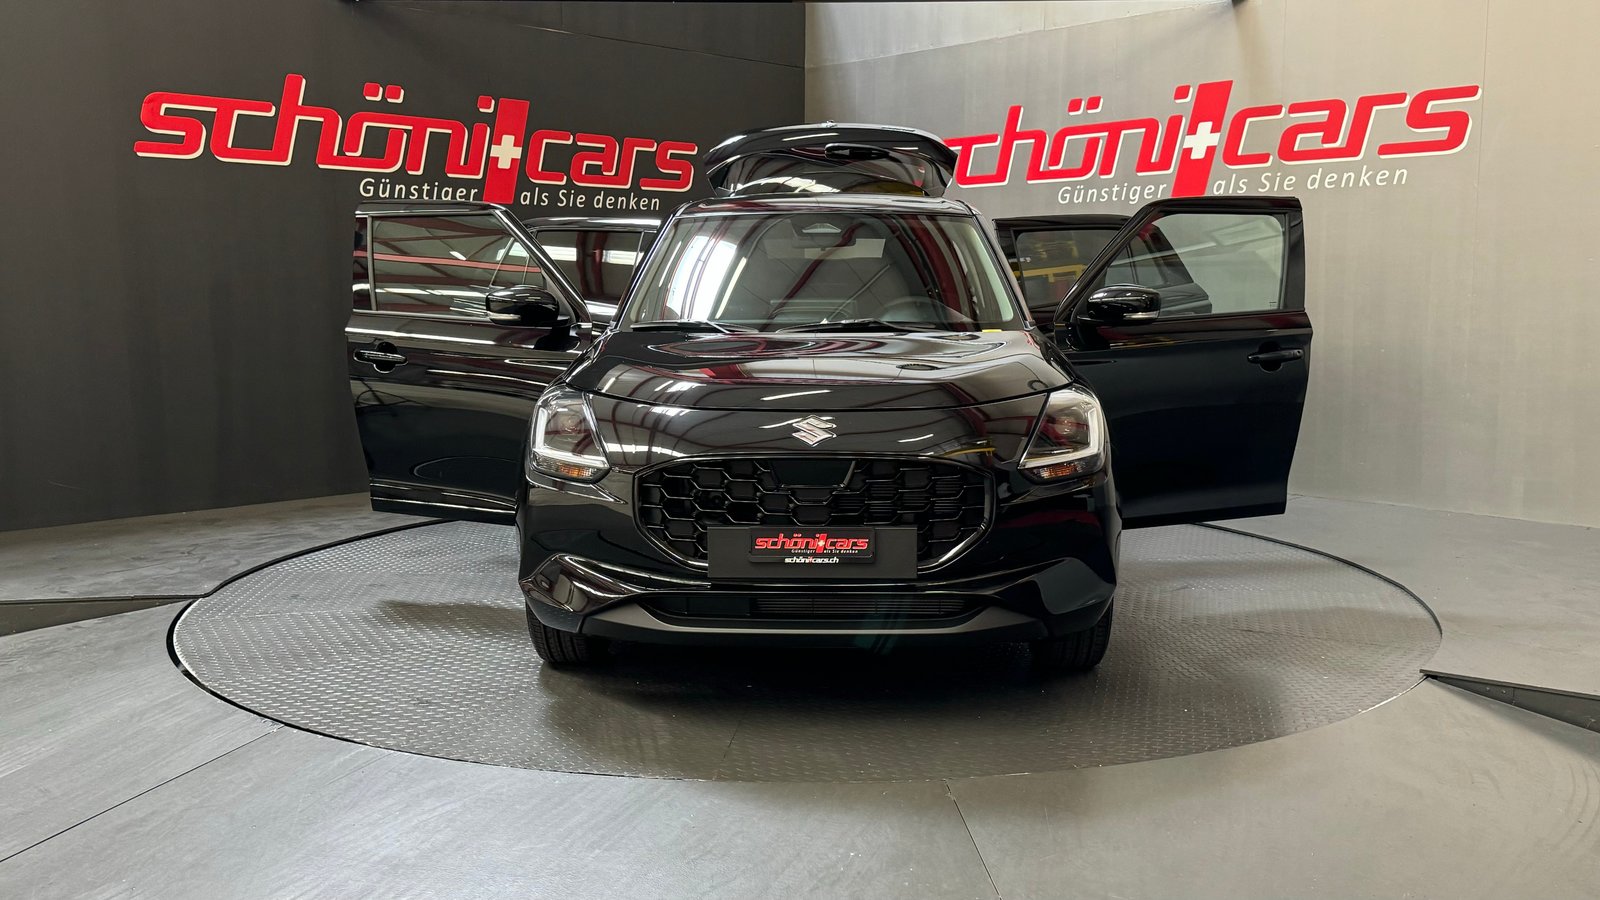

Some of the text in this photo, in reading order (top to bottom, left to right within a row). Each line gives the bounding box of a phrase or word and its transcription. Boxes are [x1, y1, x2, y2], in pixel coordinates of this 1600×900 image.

[359, 178, 661, 211] Günstiger als Sie denken
[1057, 165, 1408, 205] Günstiger als Sie denken
